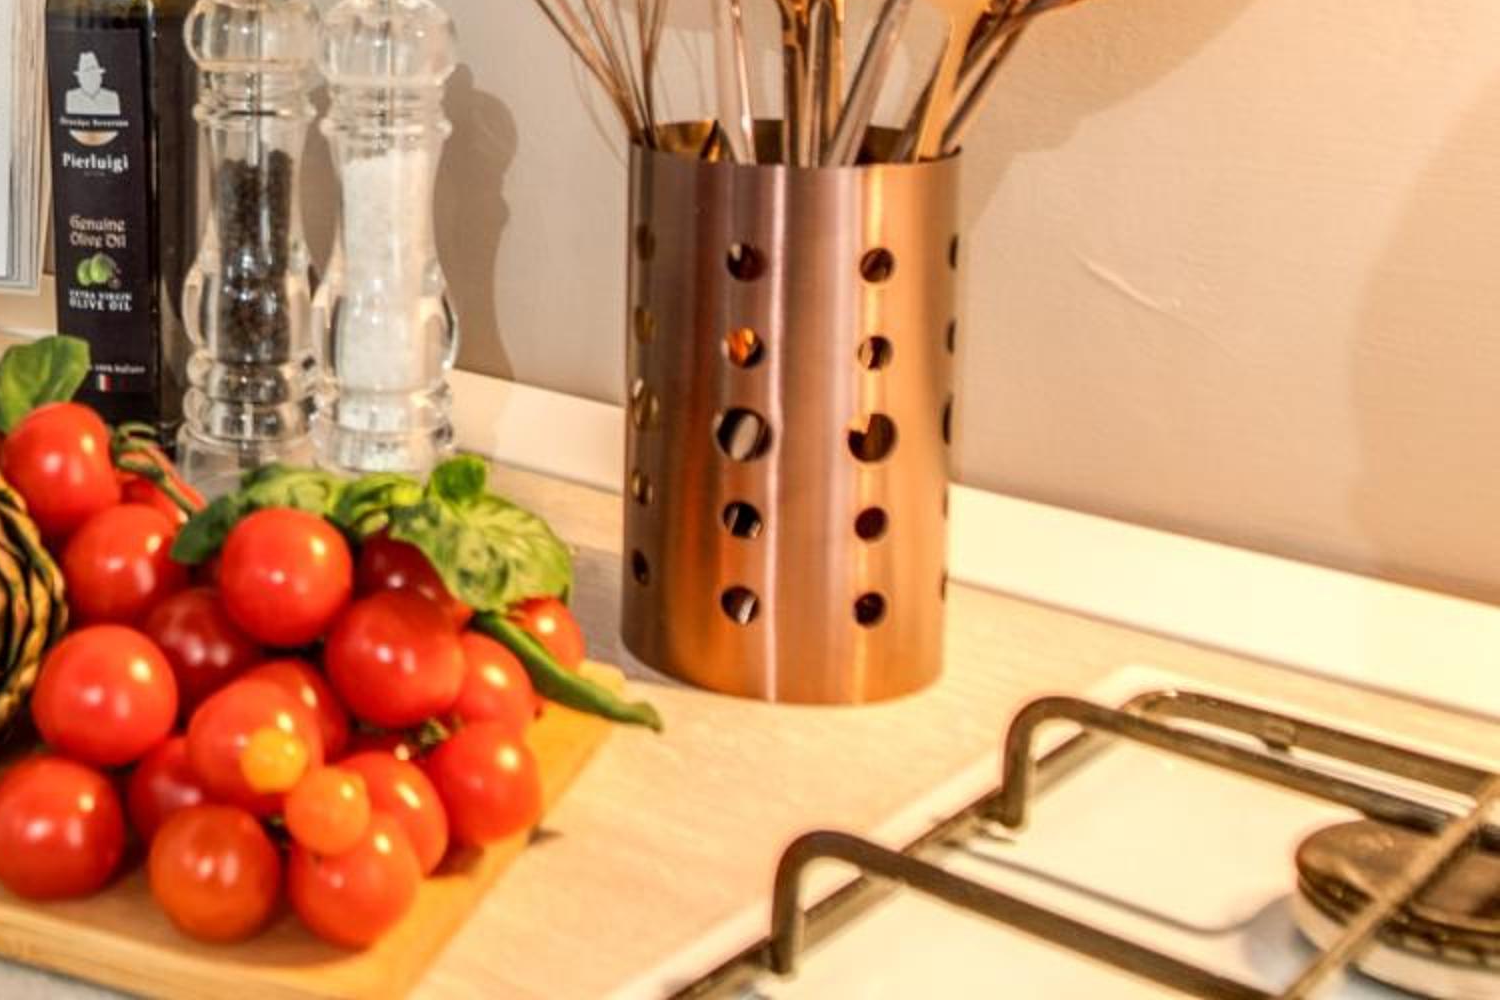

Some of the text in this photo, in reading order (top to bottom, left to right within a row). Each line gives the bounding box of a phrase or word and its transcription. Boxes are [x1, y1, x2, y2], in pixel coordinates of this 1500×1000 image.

[62, 151, 129, 174] Pierluigi
[69, 214, 125, 233] Genuine
[69, 231, 127, 249] Olive Oil
[69, 289, 132, 302] EXTRA VIRGIN
[69, 297, 132, 312] OLIVE OIL
